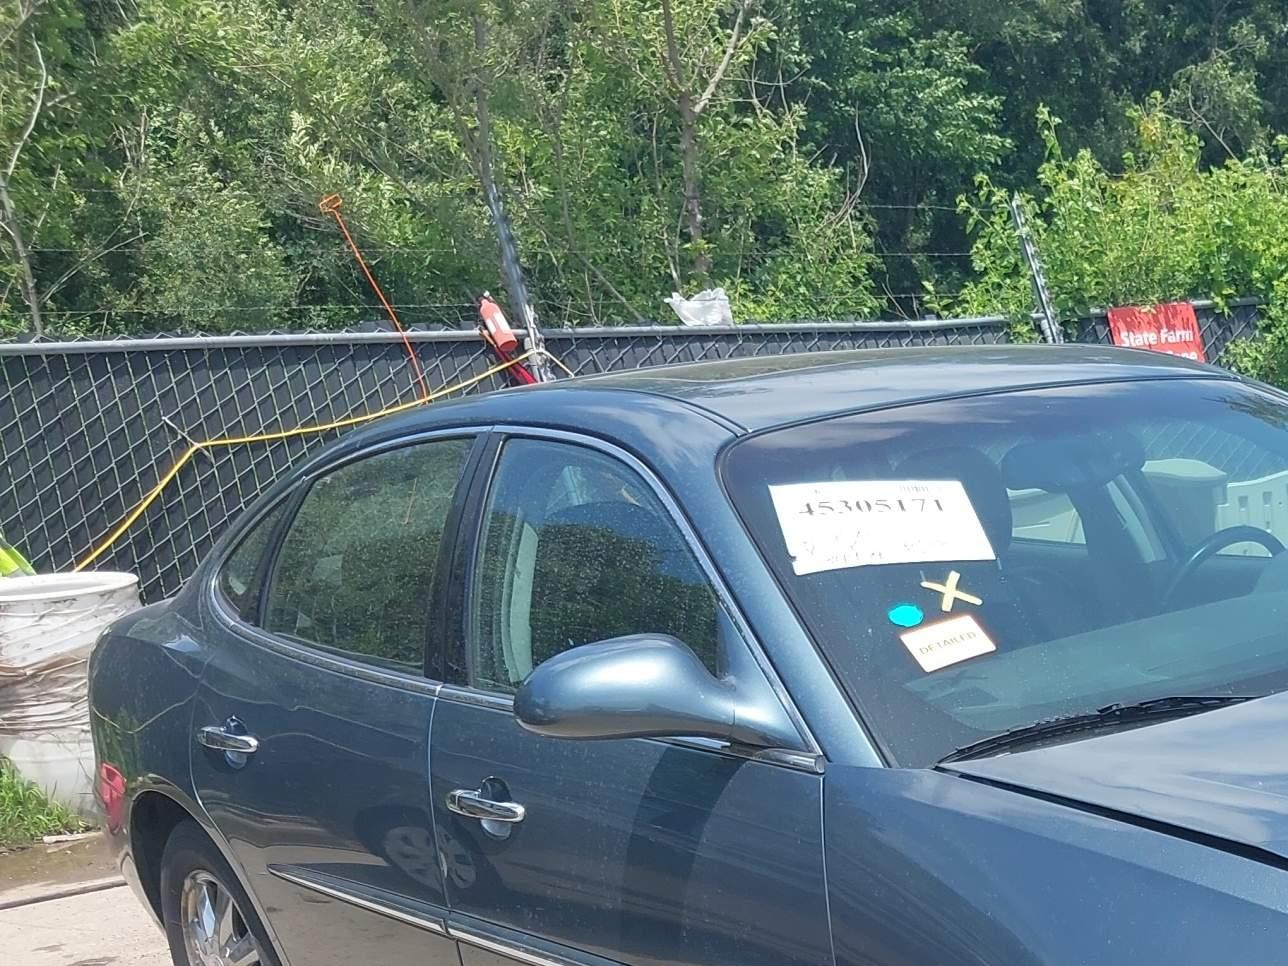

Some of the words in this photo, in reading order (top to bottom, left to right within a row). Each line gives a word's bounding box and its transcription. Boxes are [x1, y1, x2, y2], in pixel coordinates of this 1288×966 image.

[1120, 330, 1158, 346] State
[1160, 327, 1194, 343] Farm
[799, 498, 944, 516] 45305171
